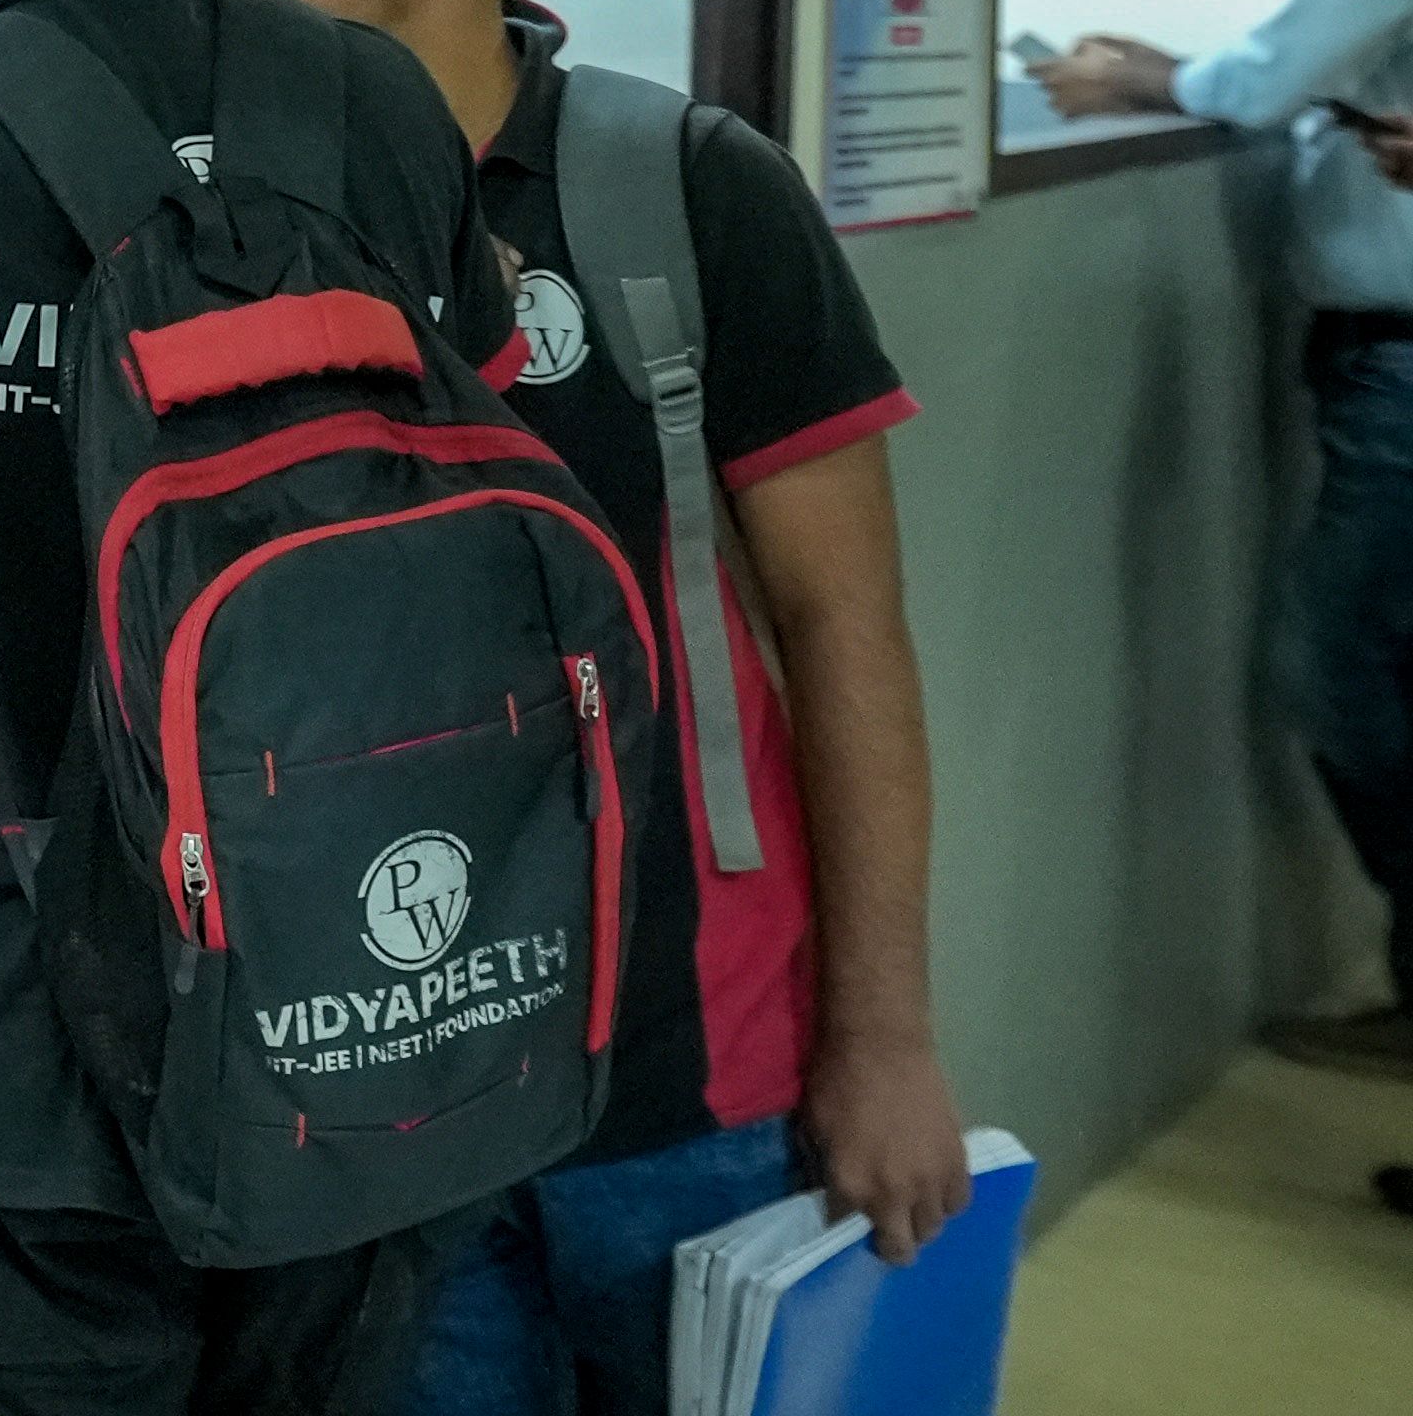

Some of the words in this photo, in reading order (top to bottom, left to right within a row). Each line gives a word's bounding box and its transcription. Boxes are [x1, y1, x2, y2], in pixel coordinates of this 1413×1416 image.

[378, 859, 459, 952] PW
[254, 928, 569, 1049] VIDYAPEETH
[368, 1033, 423, 1064] NEET
